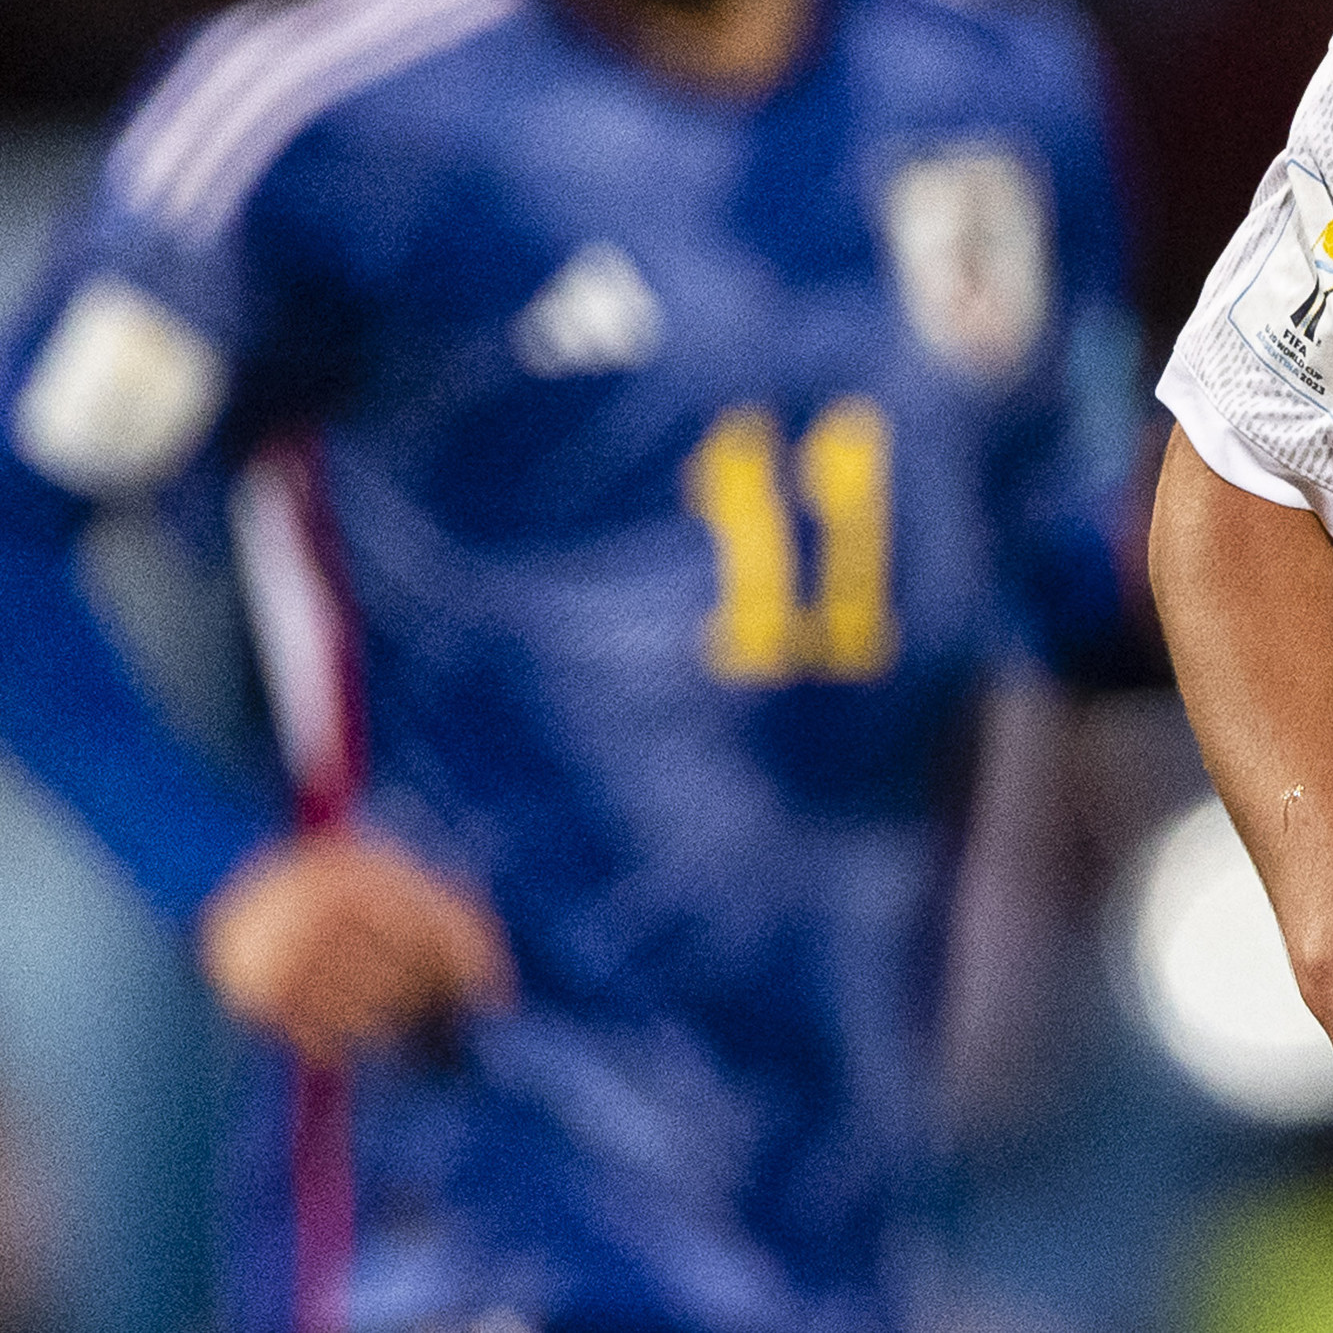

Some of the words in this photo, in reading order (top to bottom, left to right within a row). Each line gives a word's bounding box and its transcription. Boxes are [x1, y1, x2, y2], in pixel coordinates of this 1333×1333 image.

[1283, 328, 1307, 357] FIFA
[1277, 340, 1305, 369] WORLD
[1305, 366, 1324, 381] CUP
[1300, 373, 1326, 395] 2023
[684, 393, 898, 689] 11
